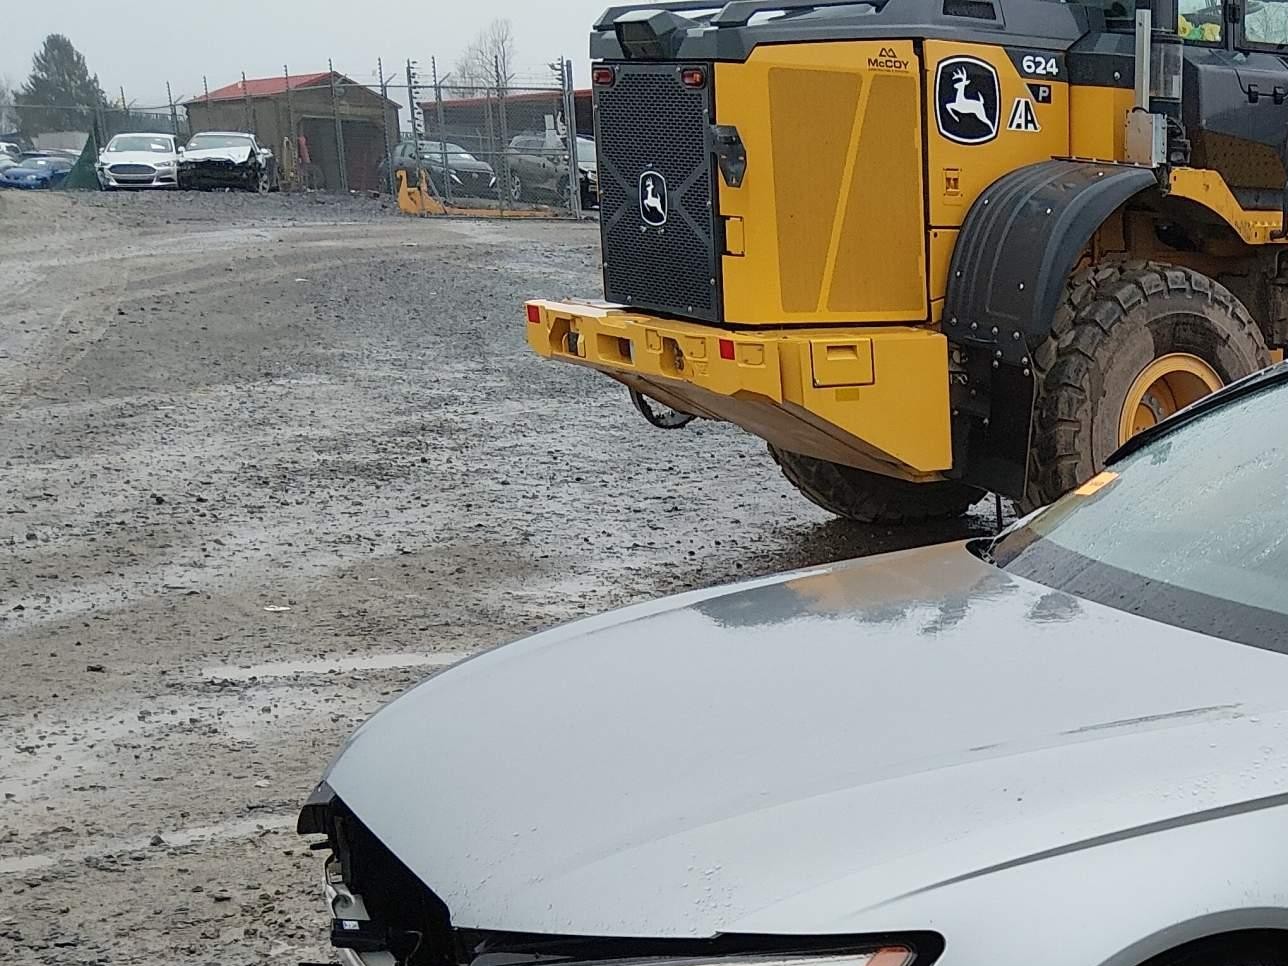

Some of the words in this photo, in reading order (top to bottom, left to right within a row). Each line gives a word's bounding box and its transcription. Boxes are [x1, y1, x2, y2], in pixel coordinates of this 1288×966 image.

[867, 58, 909, 69] McCOY
[1022, 55, 1059, 76] 624
[1038, 86, 1050, 102] P
